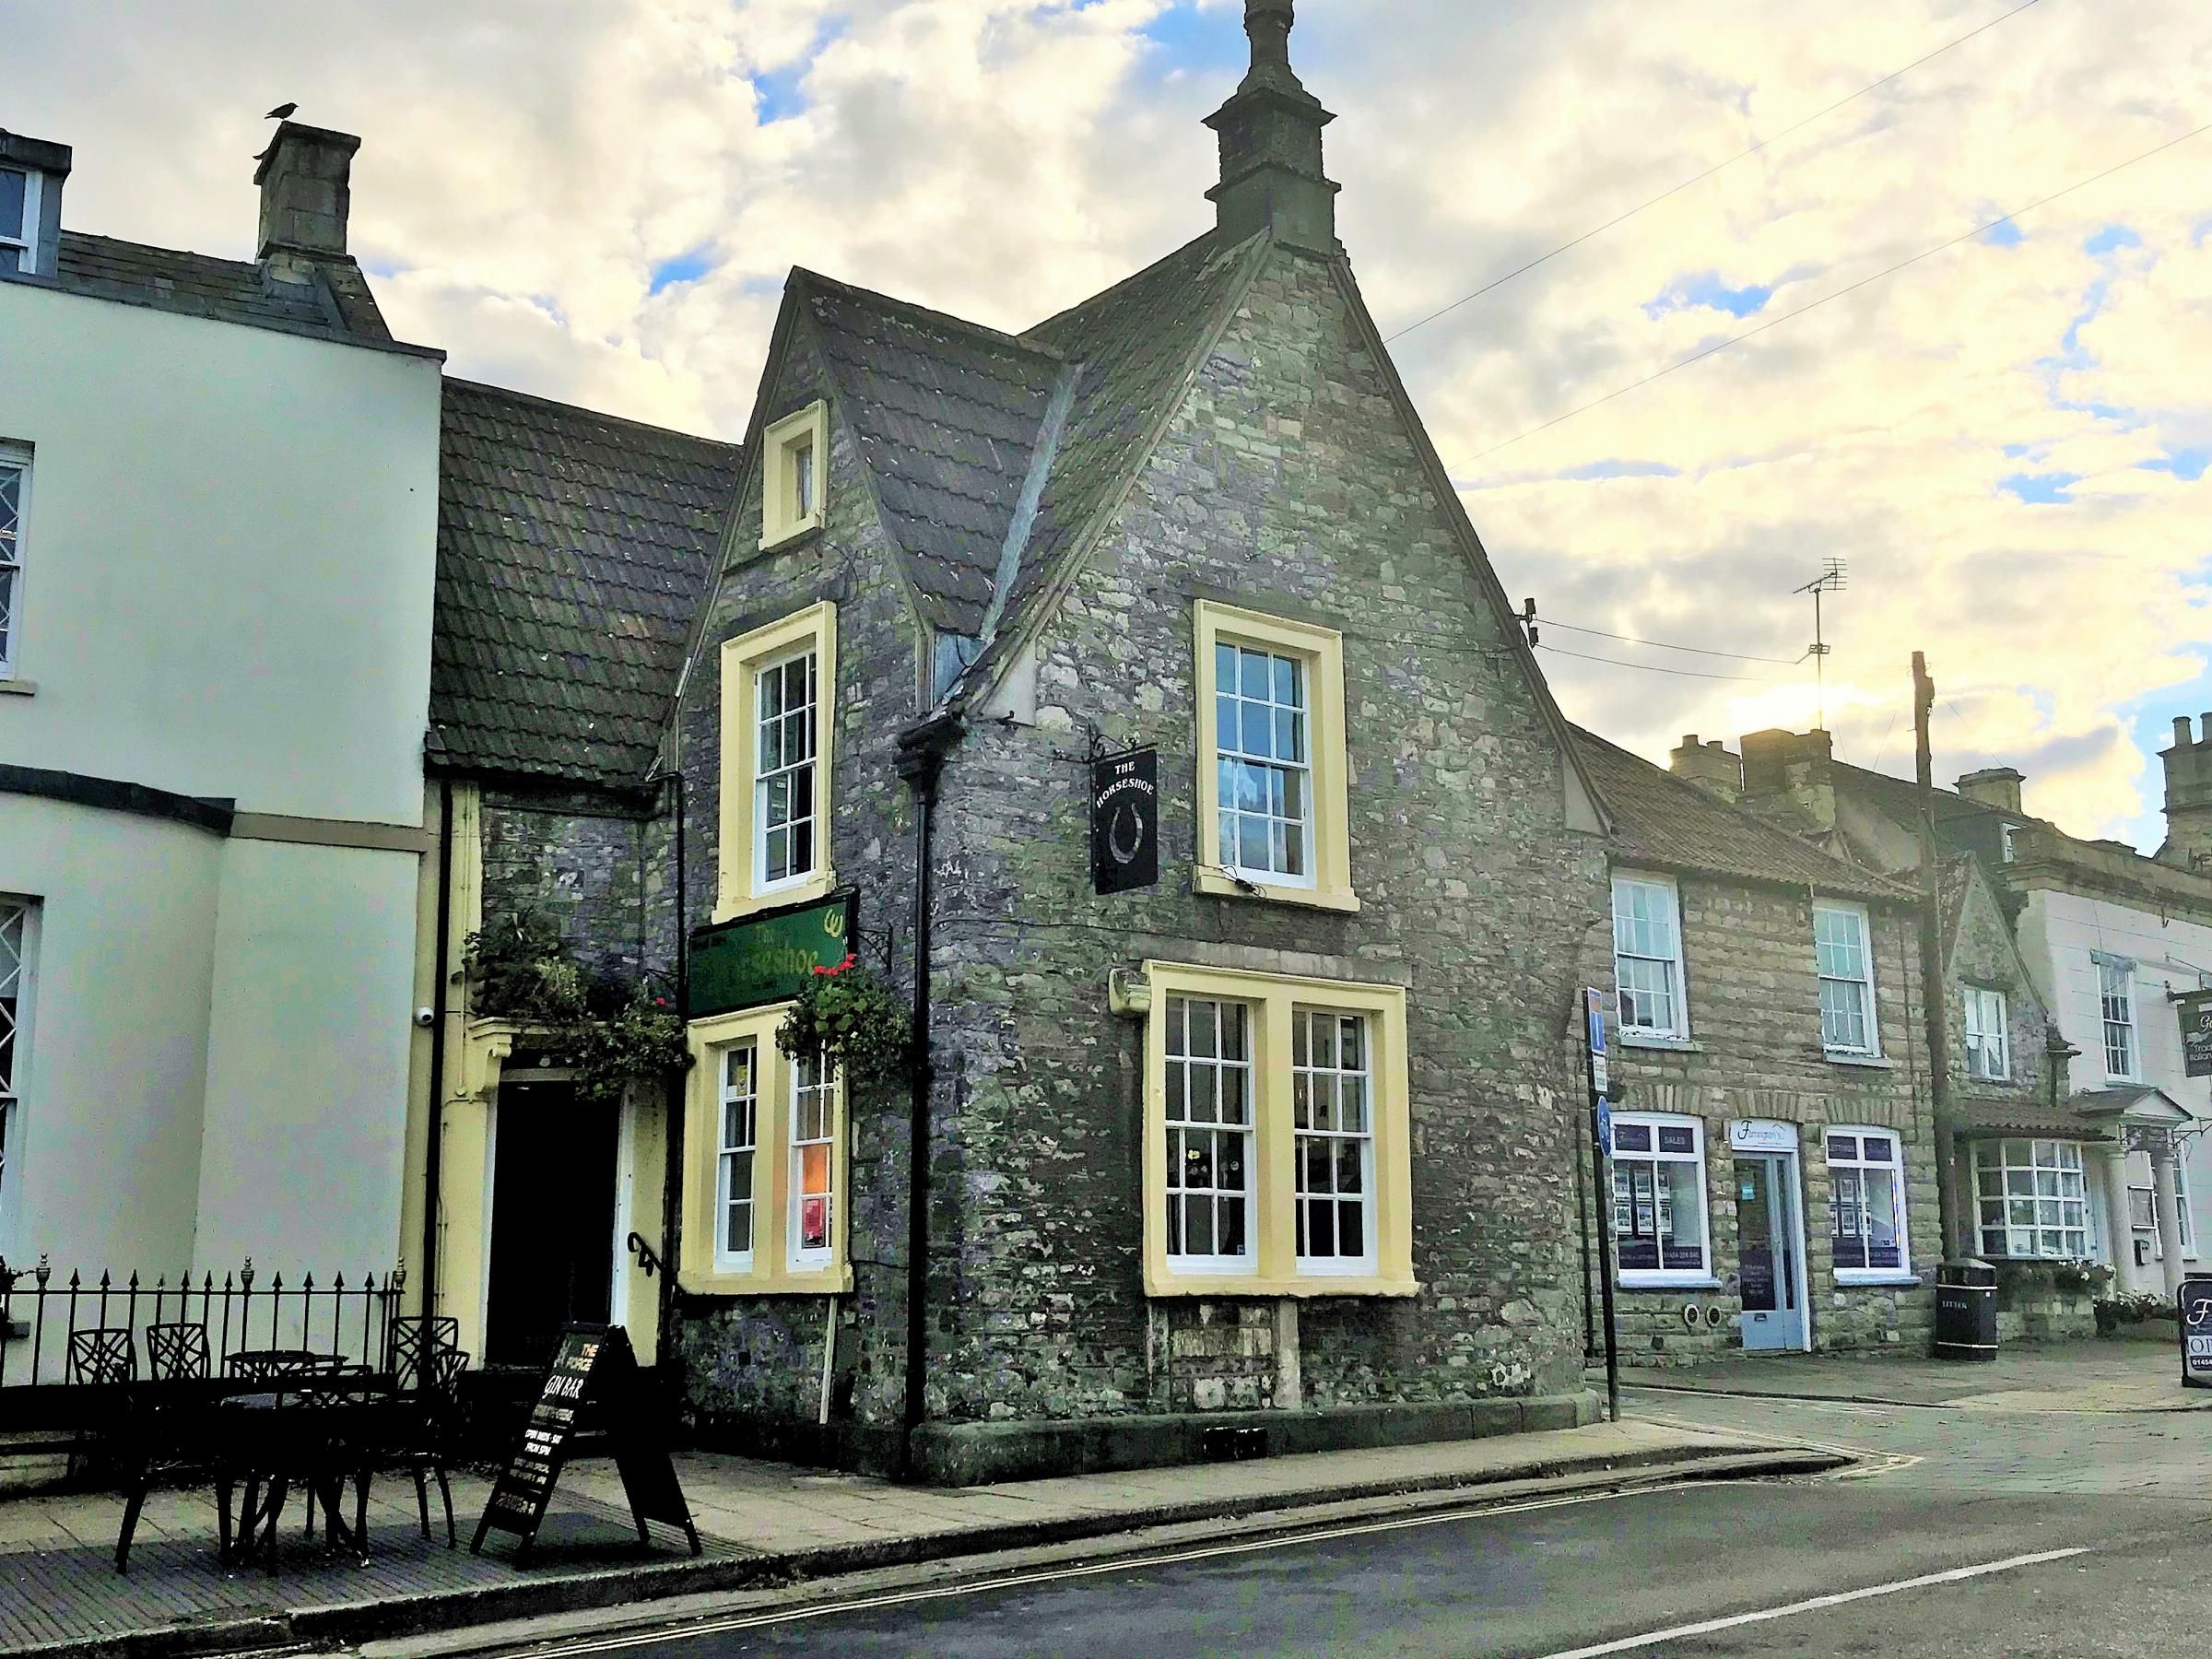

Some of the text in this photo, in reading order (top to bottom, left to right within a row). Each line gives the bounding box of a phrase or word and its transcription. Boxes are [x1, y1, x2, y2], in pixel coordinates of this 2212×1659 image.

[1115, 761, 1135, 775] THE
[1097, 778, 1155, 809] HORSESHOE
[1942, 1300, 1967, 1309] LITTER
[582, 1343, 599, 1357] THE
[542, 1374, 583, 1399] GIN BAR
